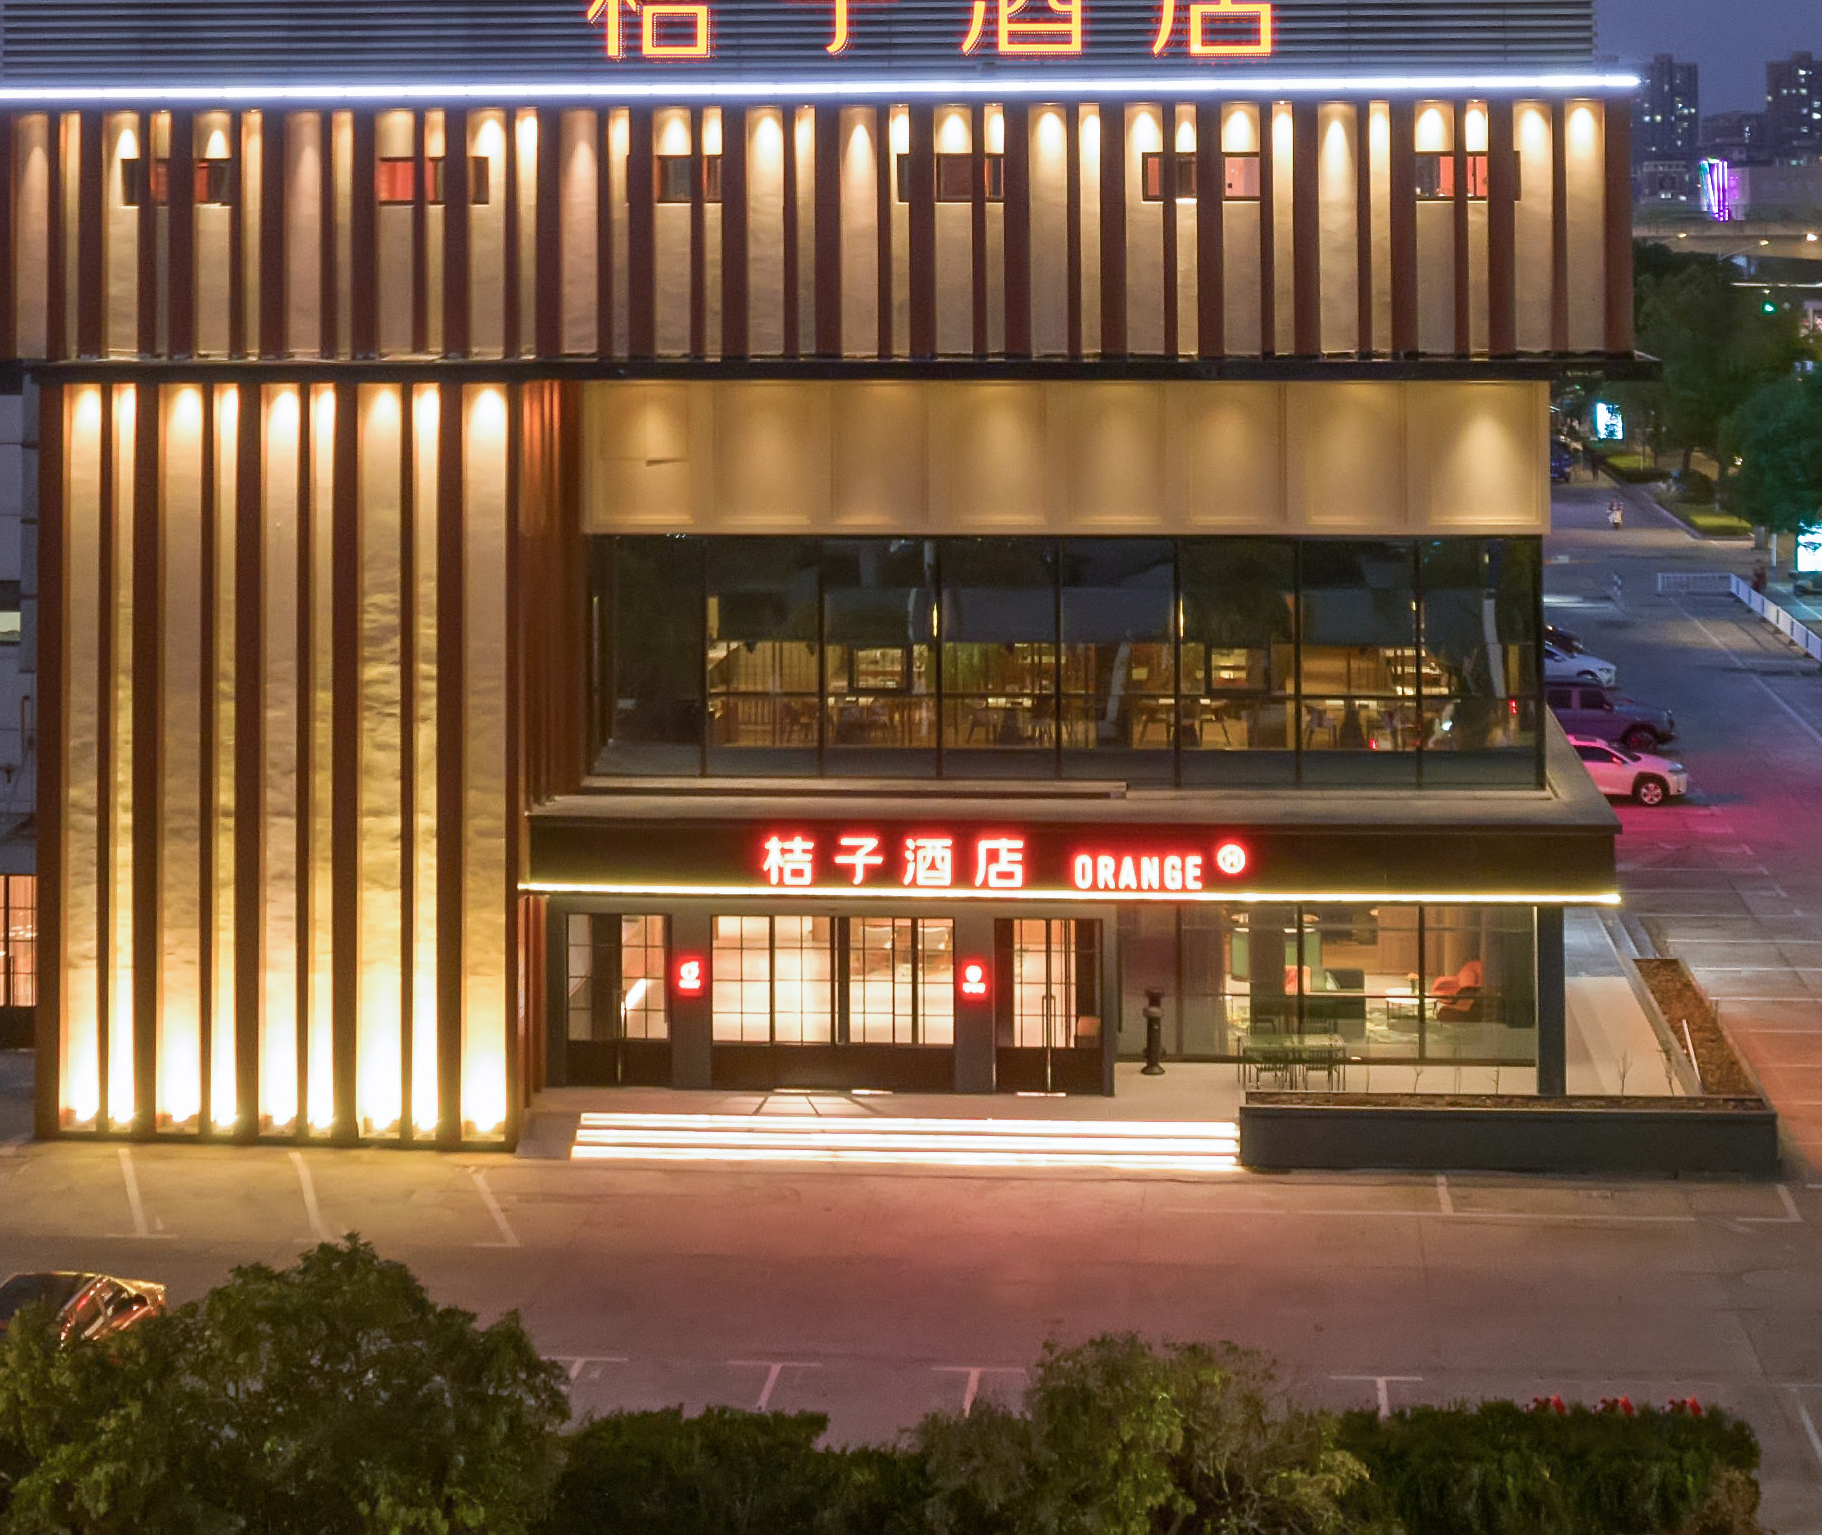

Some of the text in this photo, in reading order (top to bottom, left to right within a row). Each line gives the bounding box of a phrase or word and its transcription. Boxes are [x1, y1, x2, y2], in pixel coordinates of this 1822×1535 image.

[762, 836, 1025, 888] 桔子酒店
[1074, 855, 1203, 890] ORANGE
